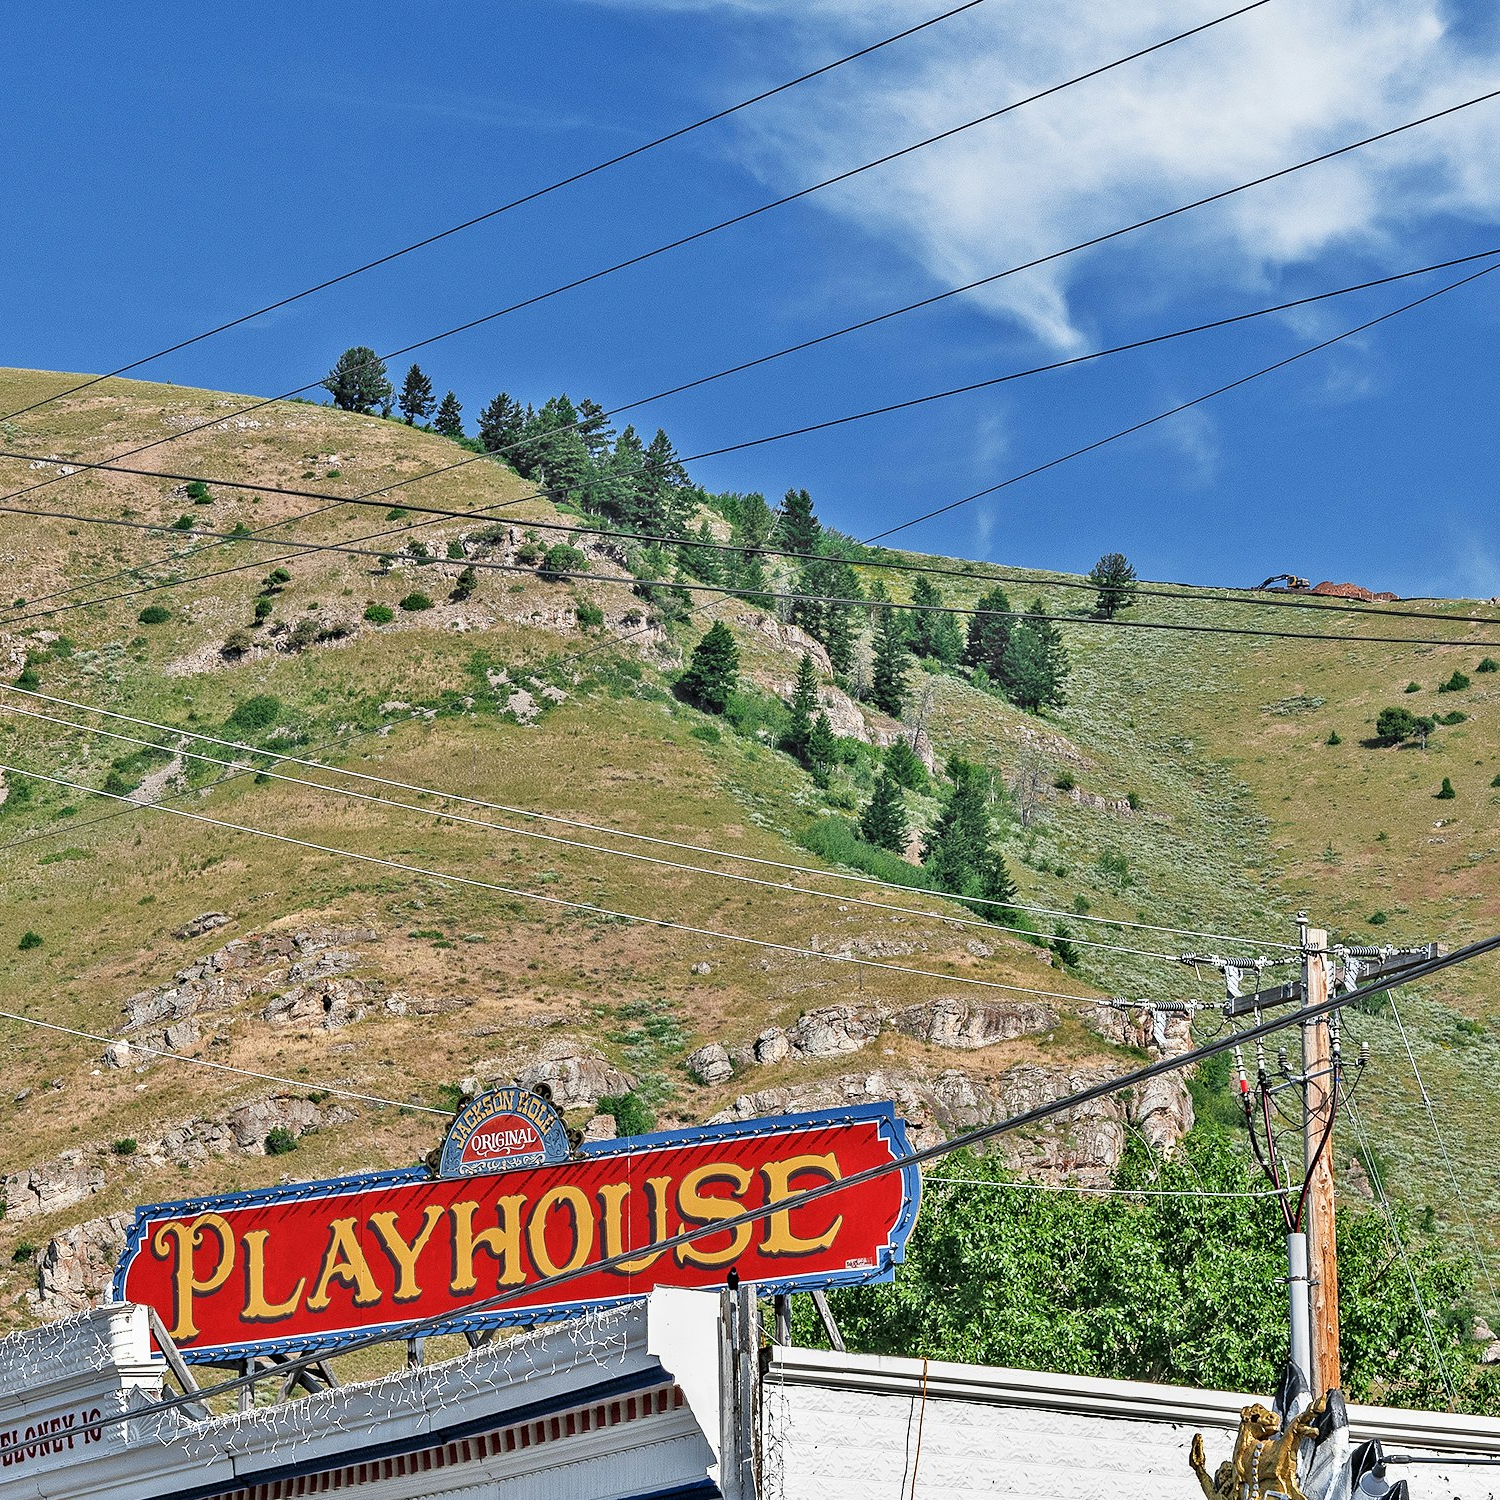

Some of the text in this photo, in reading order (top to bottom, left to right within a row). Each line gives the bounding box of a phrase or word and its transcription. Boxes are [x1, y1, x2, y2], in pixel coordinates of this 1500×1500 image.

[451, 1091, 555, 1149] JACKSON HOLE
[471, 1128, 537, 1152] ORIGINAL
[153, 1154, 844, 1342] PLAYHOUSE
